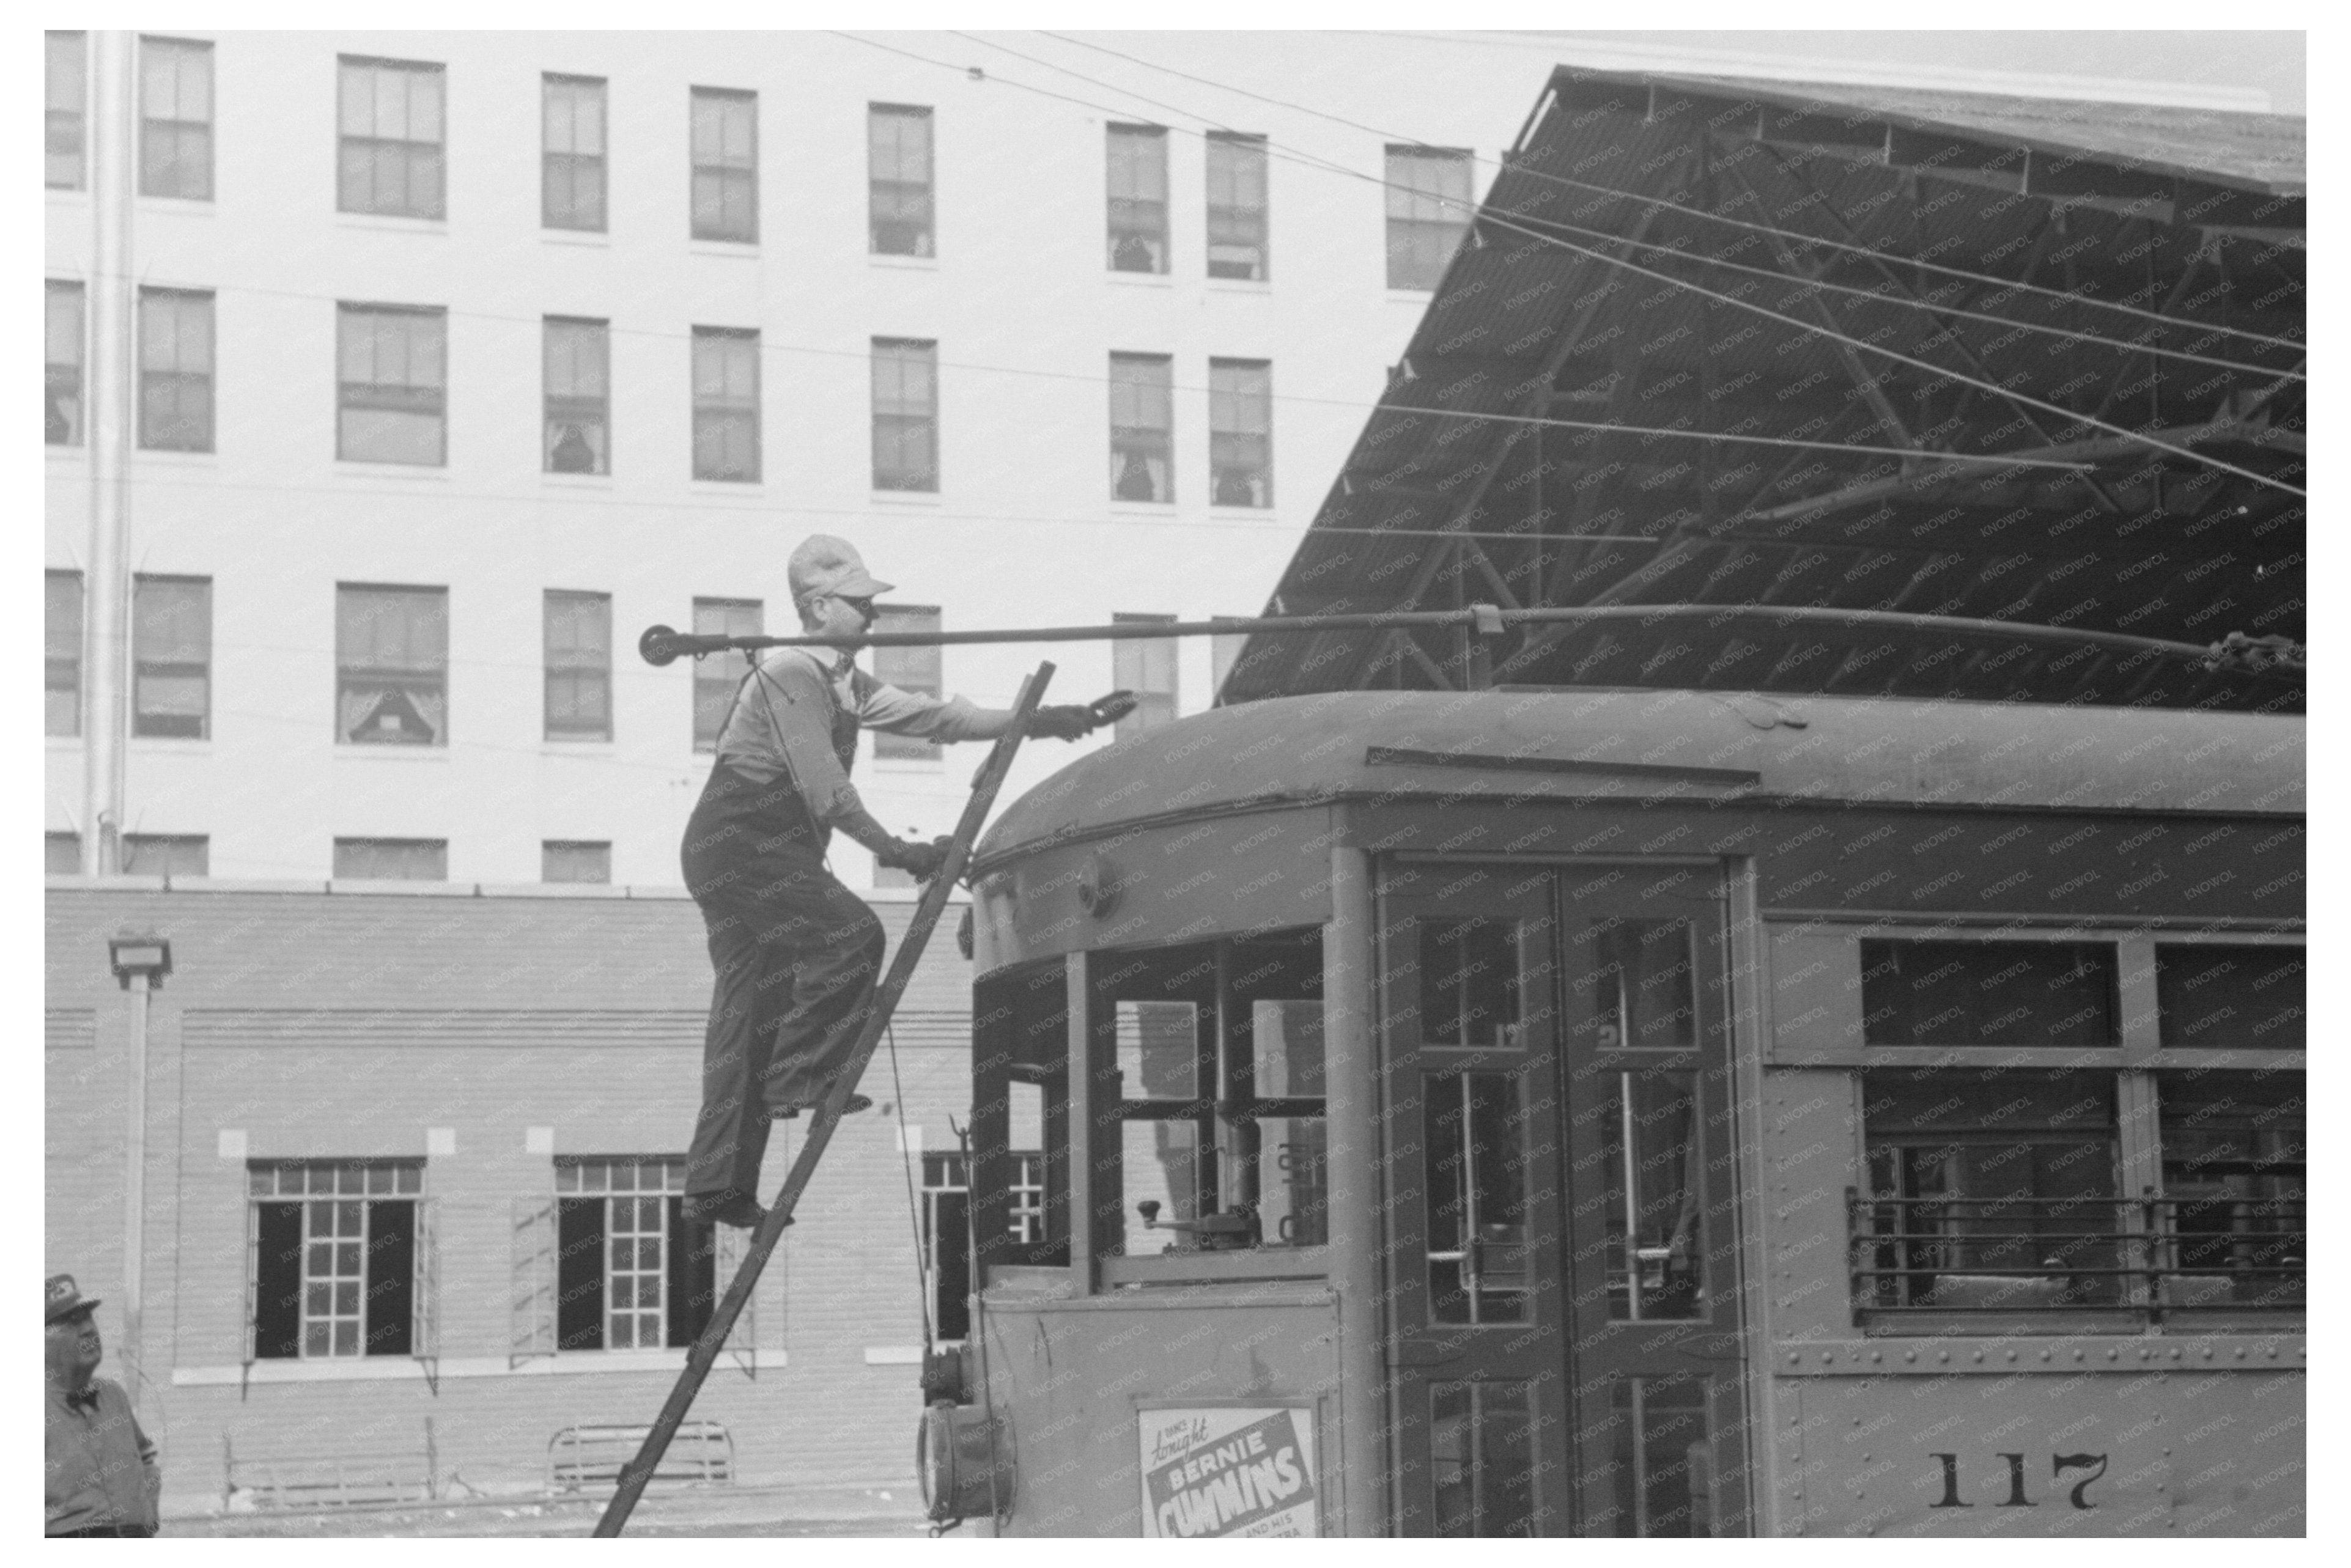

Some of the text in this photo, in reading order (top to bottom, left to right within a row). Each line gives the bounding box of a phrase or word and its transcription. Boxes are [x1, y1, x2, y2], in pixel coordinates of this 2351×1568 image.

[1168, 1430, 1267, 1491] BERNIE
[1929, 1453, 2107, 1509] 117
[1158, 1446, 1302, 1537] CUMMINS
[1271, 1512, 1293, 1528] HIS
